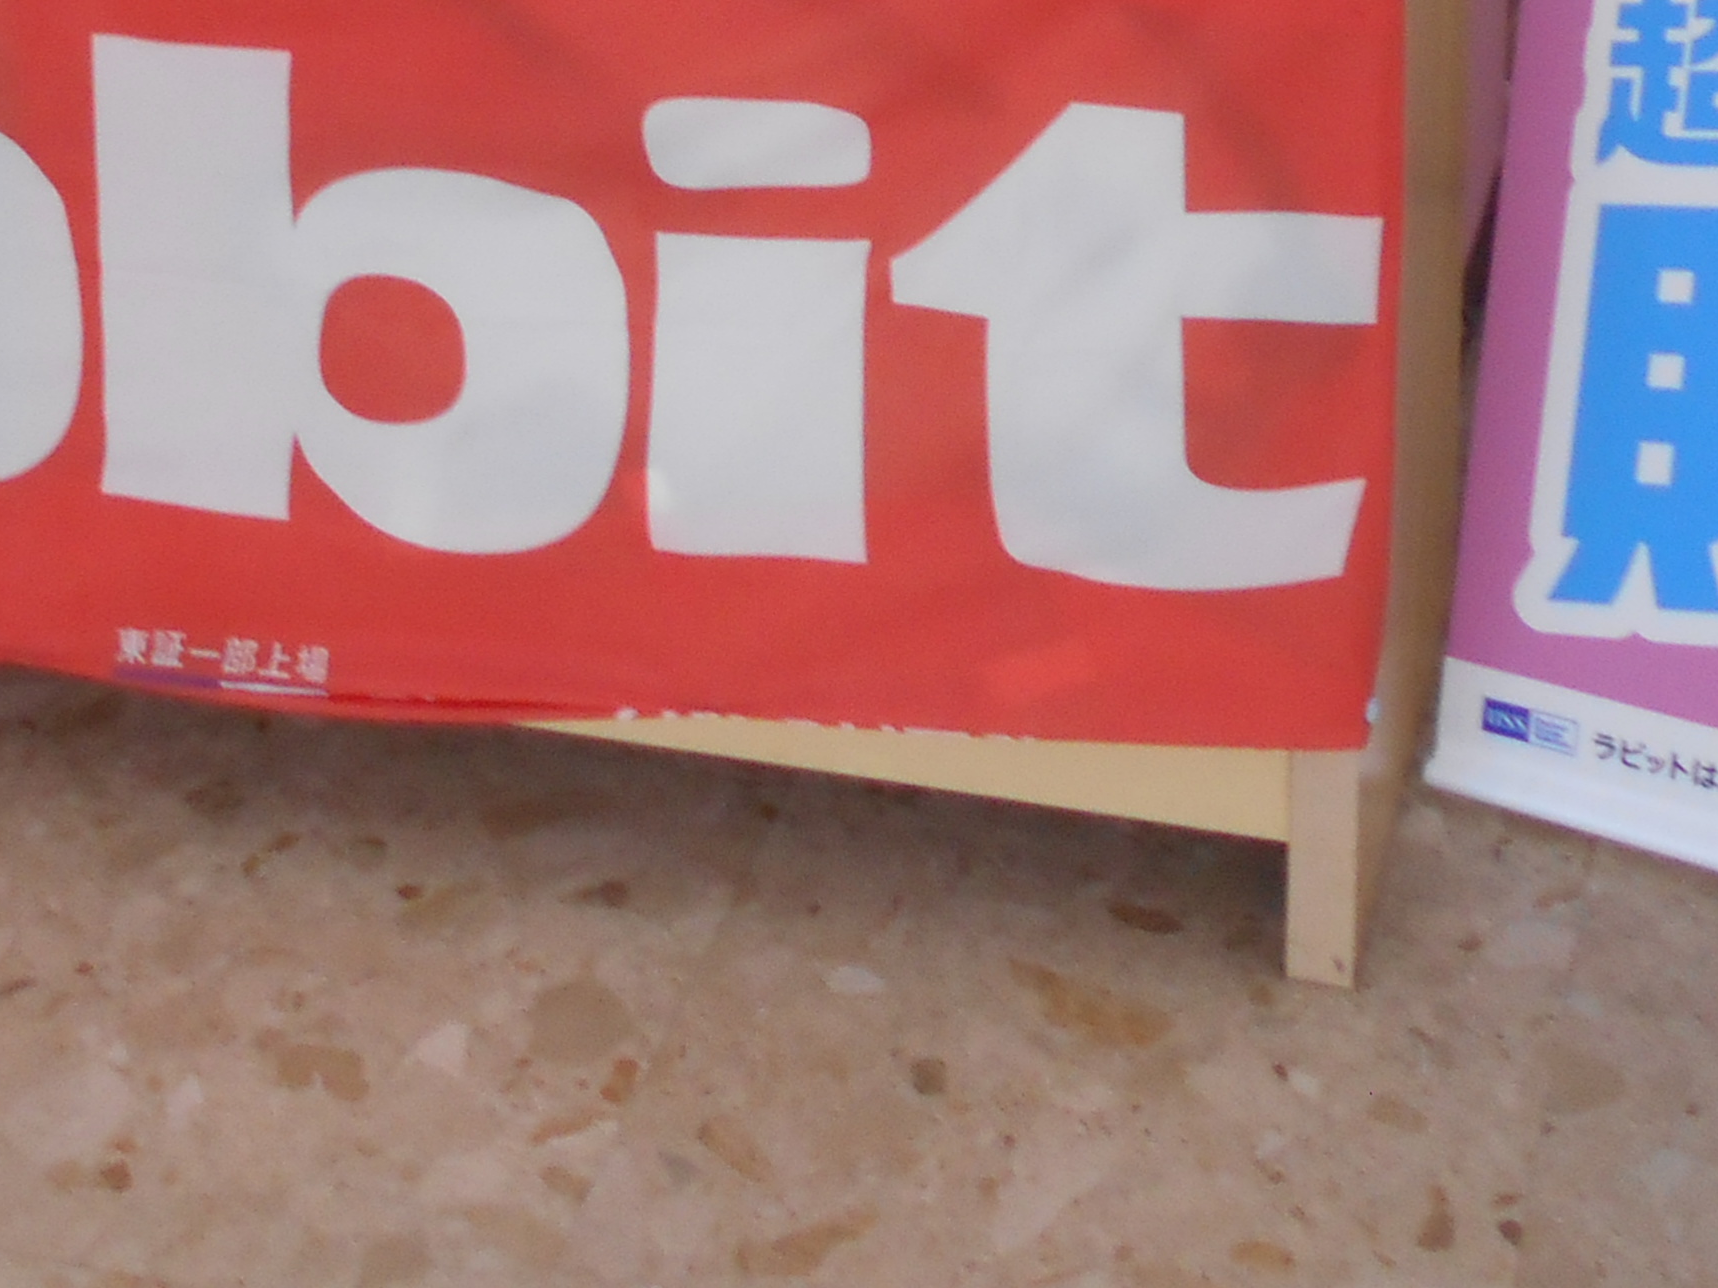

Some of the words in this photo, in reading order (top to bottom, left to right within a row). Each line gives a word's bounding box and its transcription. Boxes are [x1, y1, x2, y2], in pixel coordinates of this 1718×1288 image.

[116, 627, 330, 684] 東証一部上場
